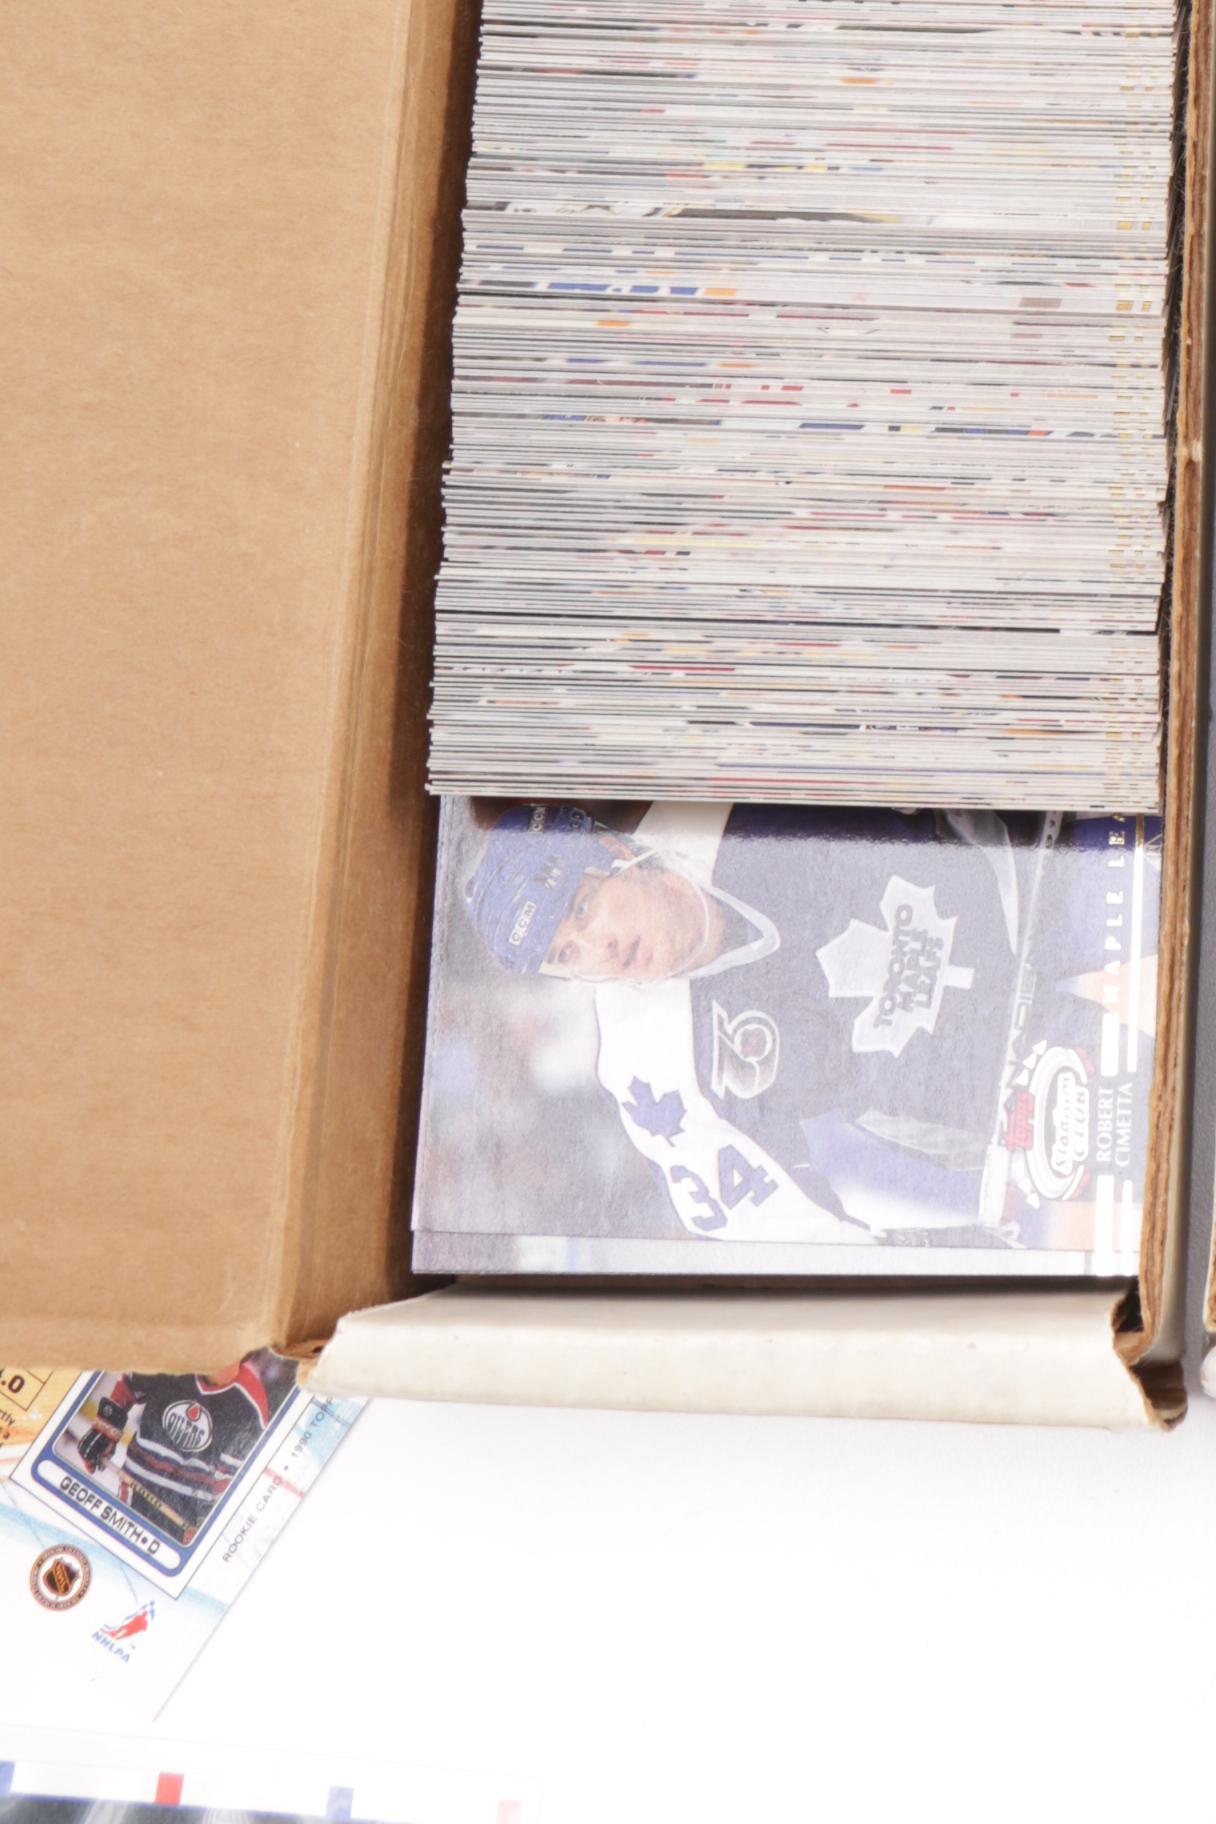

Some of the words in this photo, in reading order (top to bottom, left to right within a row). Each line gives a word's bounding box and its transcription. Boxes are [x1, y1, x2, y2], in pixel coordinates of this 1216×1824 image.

[509, 901, 535, 946] CCM
[1096, 1086, 1113, 1162] ROBERT
[1115, 1082, 1133, 1166] CIMETTA
[670, 1144, 779, 1232] 34
[59, 1476, 102, 1510] GEOFF
[101, 1506, 143, 1544] SMITH
[222, 1516, 256, 1562] ROOKIE
